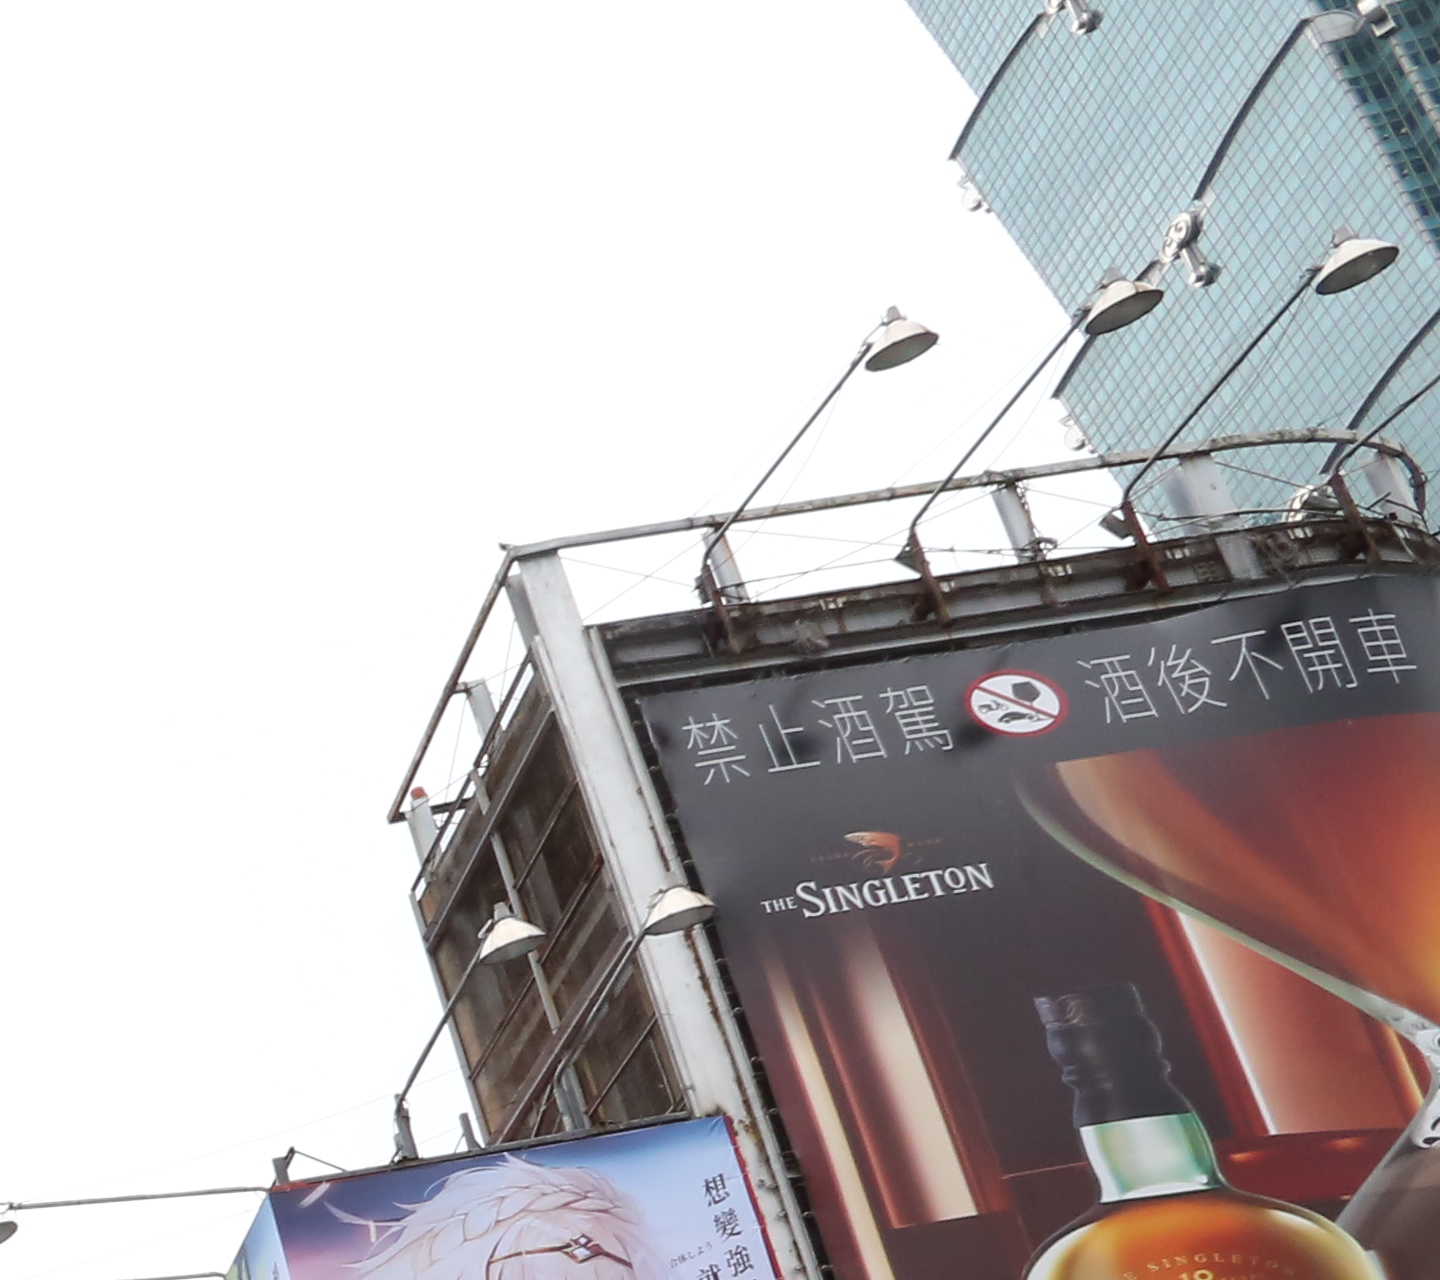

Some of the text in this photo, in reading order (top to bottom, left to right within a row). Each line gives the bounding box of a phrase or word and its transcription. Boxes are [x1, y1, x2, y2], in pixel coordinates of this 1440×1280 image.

[681, 606, 1418, 785] 禁止酒駕 酒後不開車
[761, 862, 996, 919] THE SINGLETON
